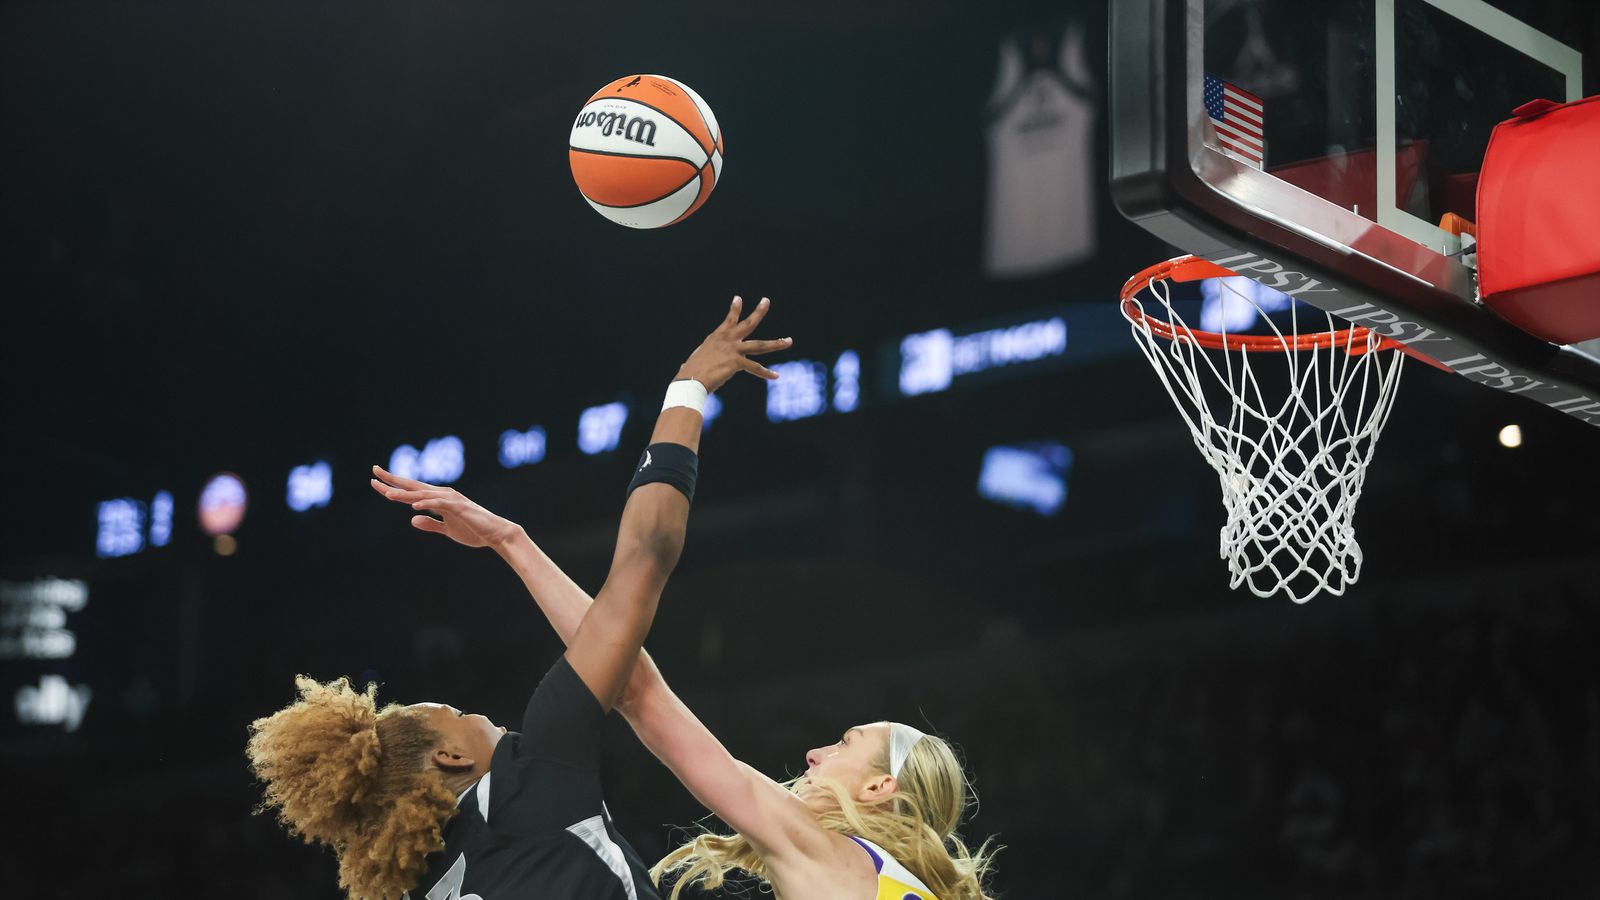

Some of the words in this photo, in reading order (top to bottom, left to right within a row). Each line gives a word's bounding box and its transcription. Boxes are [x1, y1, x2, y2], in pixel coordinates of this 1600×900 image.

[576, 110, 657, 147] Wilson
[1210, 252, 1338, 295] IPSY
[1329, 302, 1453, 345] IPSY
[1440, 353, 1559, 393] IPSY
[1545, 395, 1600, 427] IP
